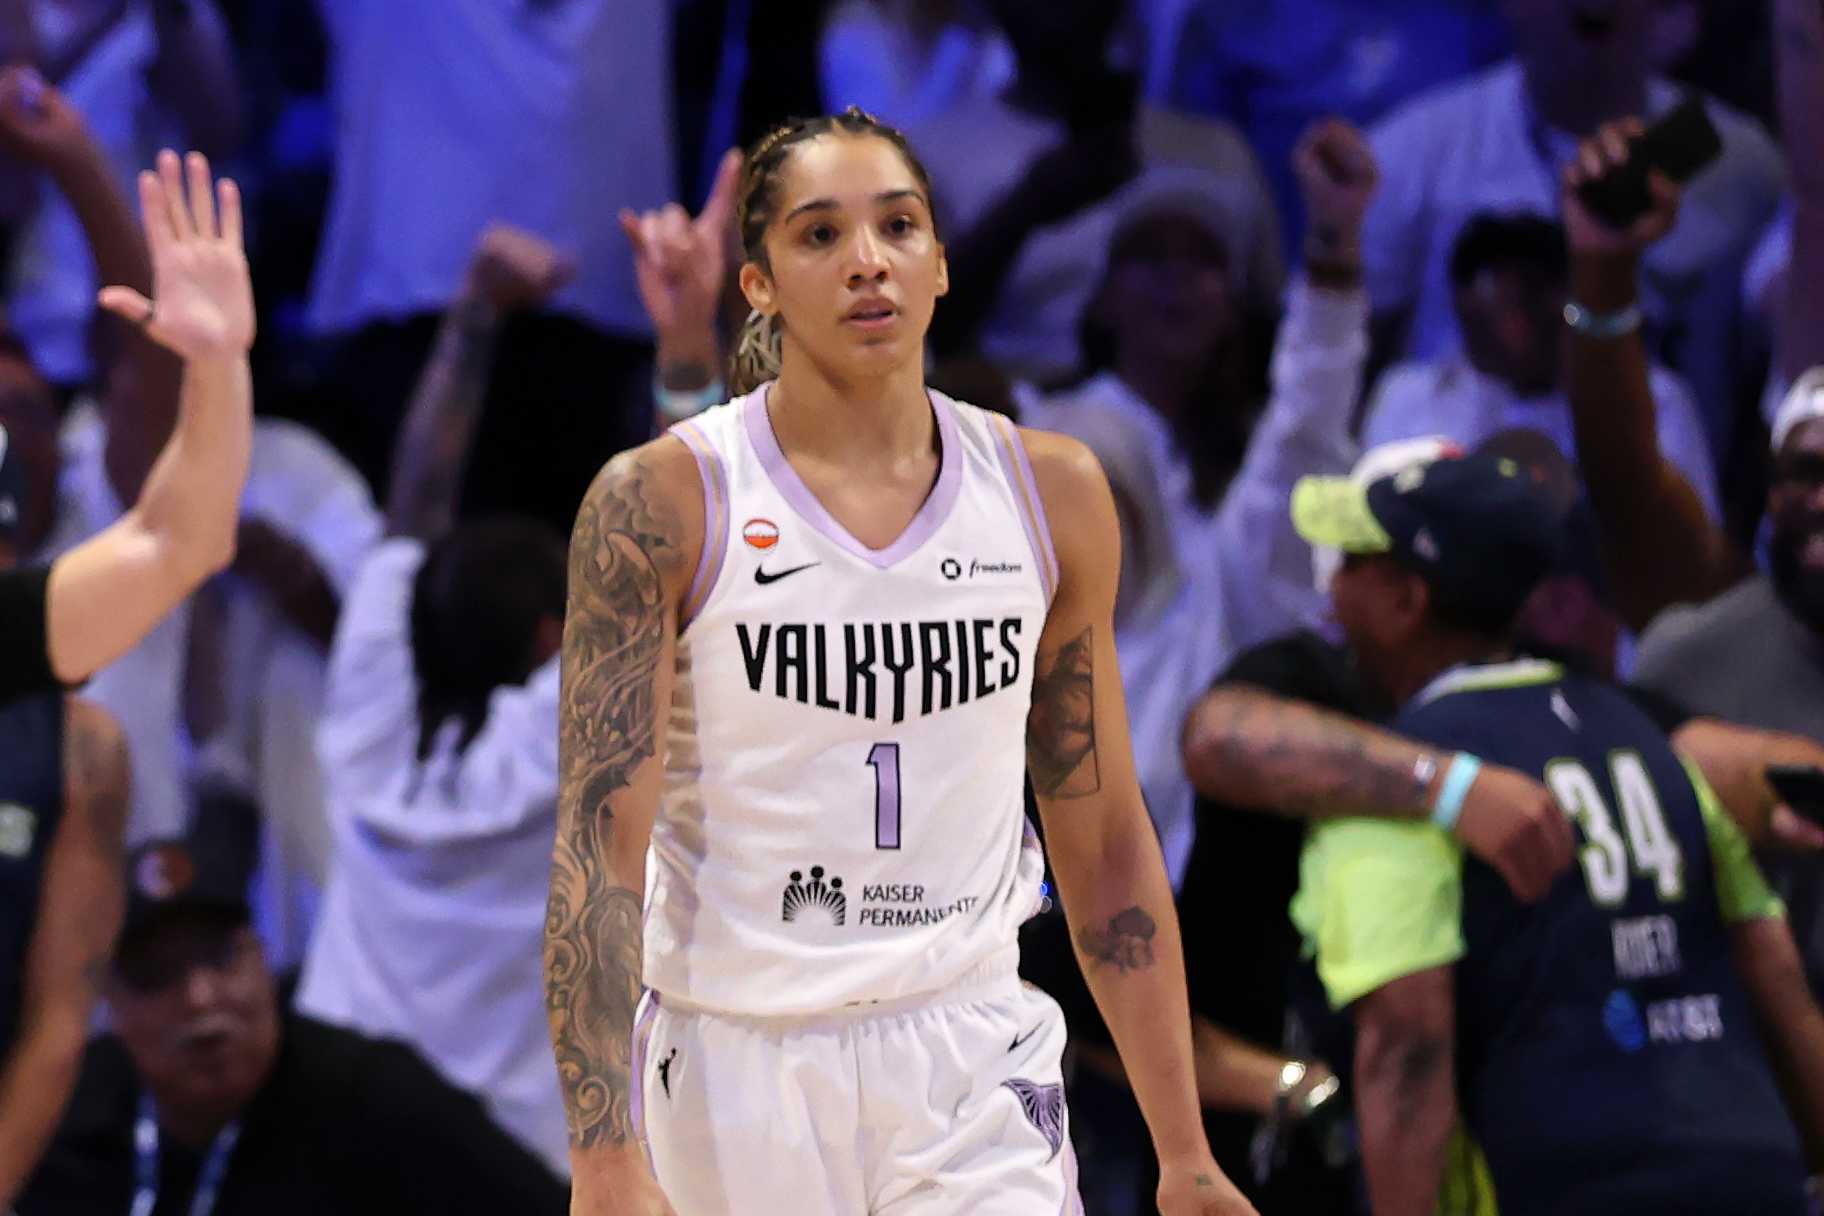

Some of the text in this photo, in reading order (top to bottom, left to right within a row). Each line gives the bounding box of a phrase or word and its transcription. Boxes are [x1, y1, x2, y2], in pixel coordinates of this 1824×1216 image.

[736, 617, 1022, 725] VALKYRIES
[865, 742, 902, 850] 1
[1545, 747, 1683, 907] 34
[862, 884, 925, 902] KAISER
